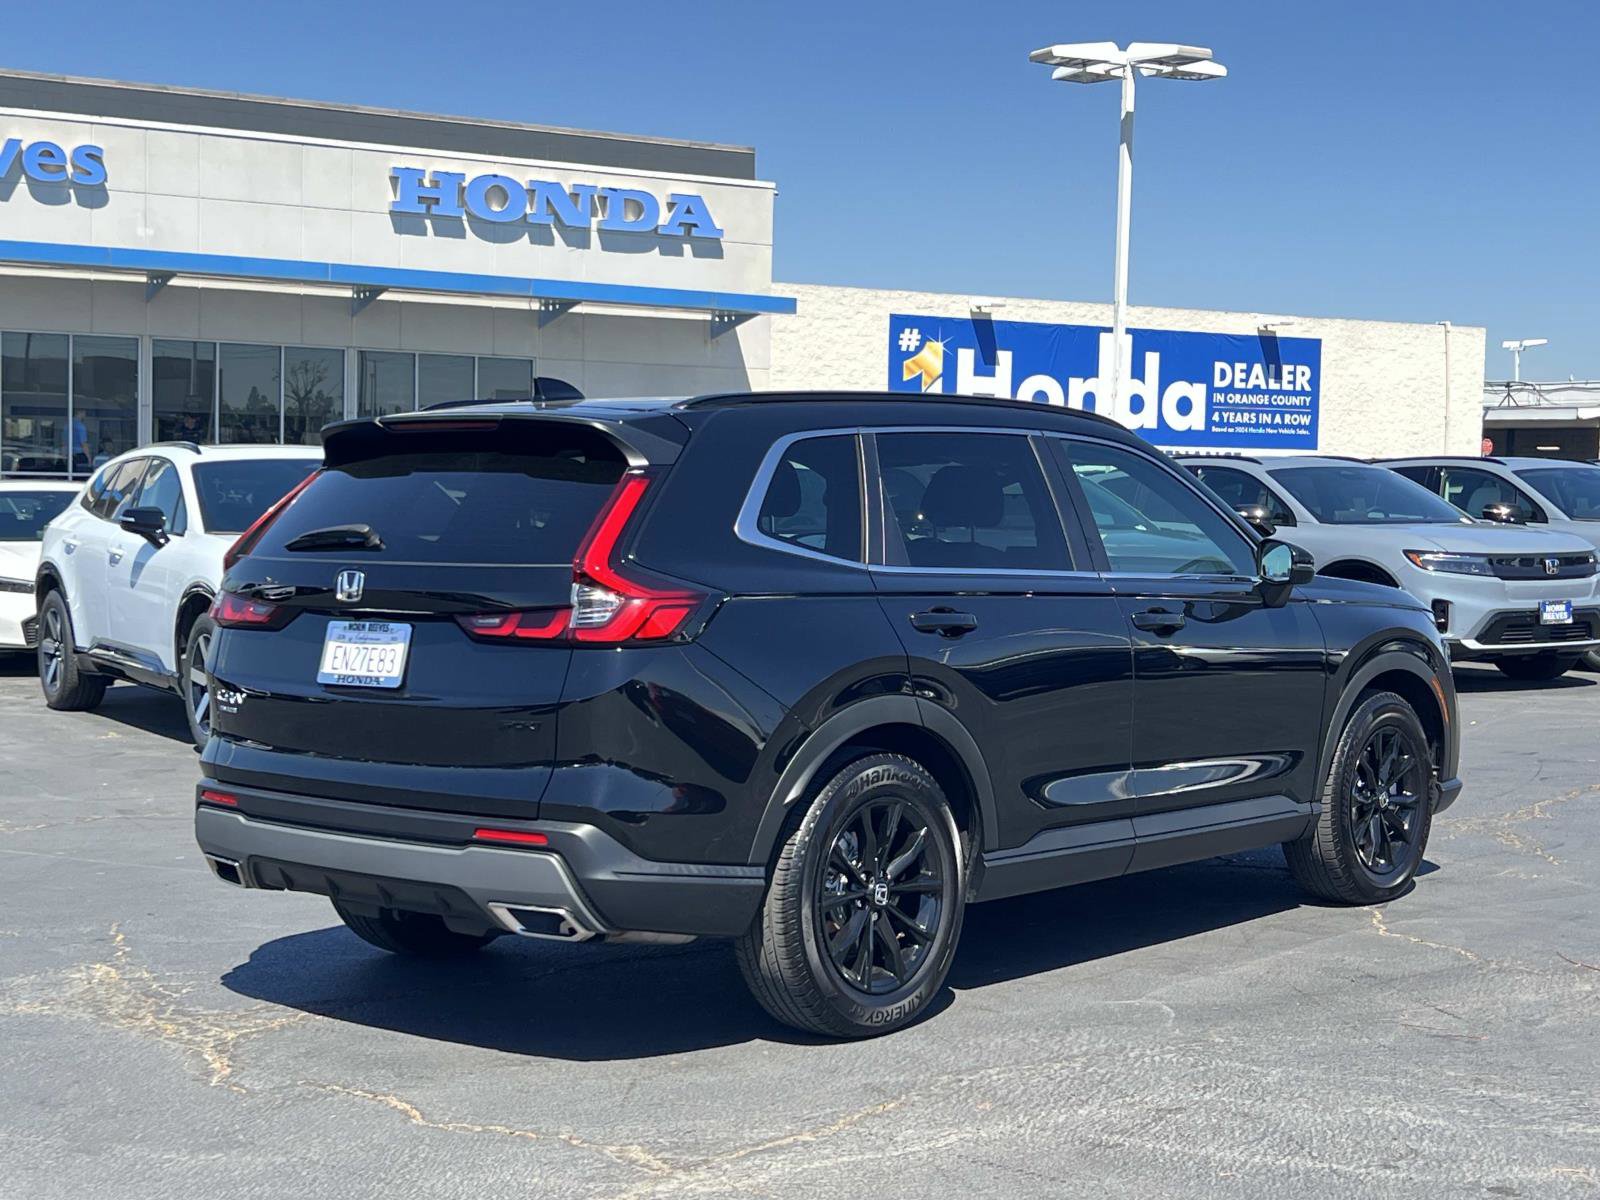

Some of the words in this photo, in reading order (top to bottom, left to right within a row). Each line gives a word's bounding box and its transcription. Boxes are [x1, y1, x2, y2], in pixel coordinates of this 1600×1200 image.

[389, 167, 724, 238] HONDA
[1213, 361, 1312, 391] DEALER
[1213, 393, 1224, 403] IN
[1226, 393, 1269, 405] ORANGE
[1271, 396, 1312, 406] COUNTY
[1212, 412, 1220, 423] 4
[1222, 412, 1257, 424] YEARS
[1259, 414, 1271, 424] IN
[1273, 414, 1282, 425] A
[1284, 415, 1312, 426] ROW
[331, 645, 397, 674] EN27E83
[336, 675, 382, 685] HONDA
